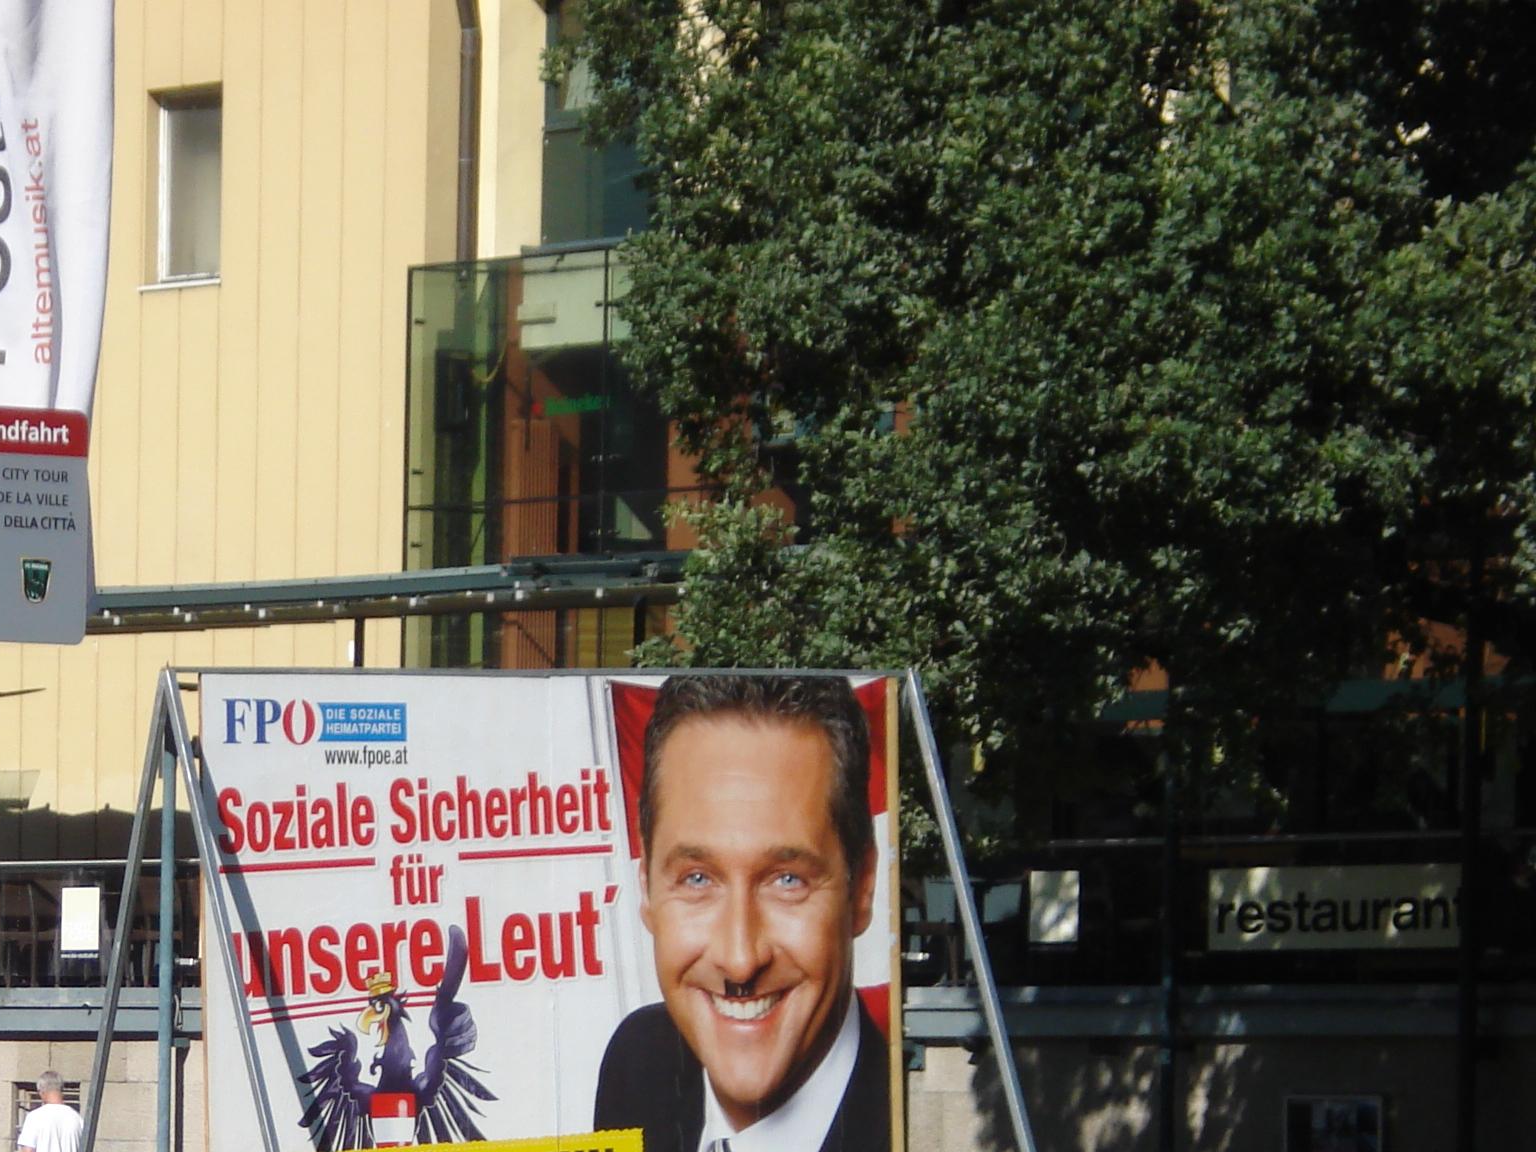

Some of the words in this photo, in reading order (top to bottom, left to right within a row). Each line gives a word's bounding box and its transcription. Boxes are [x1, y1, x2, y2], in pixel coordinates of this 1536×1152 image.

[20, 118, 53, 365] altemusik.at
[2, 468, 30, 482] CITY
[34, 469, 69, 484] TOUR
[16, 491, 32, 505] LA
[36, 492, 69, 507] VILLE
[3, 514, 39, 530] DELLA
[325, 707, 346, 721] DIE
[349, 707, 402, 721] SOZIALE
[324, 720, 402, 736] HEIMATPARTEI
[324, 747, 408, 768] www.fpoe.at
[218, 782, 376, 855] Soziale
[389, 767, 612, 844] Sicherheit
[389, 853, 445, 906] für
[231, 917, 445, 998] unsere
